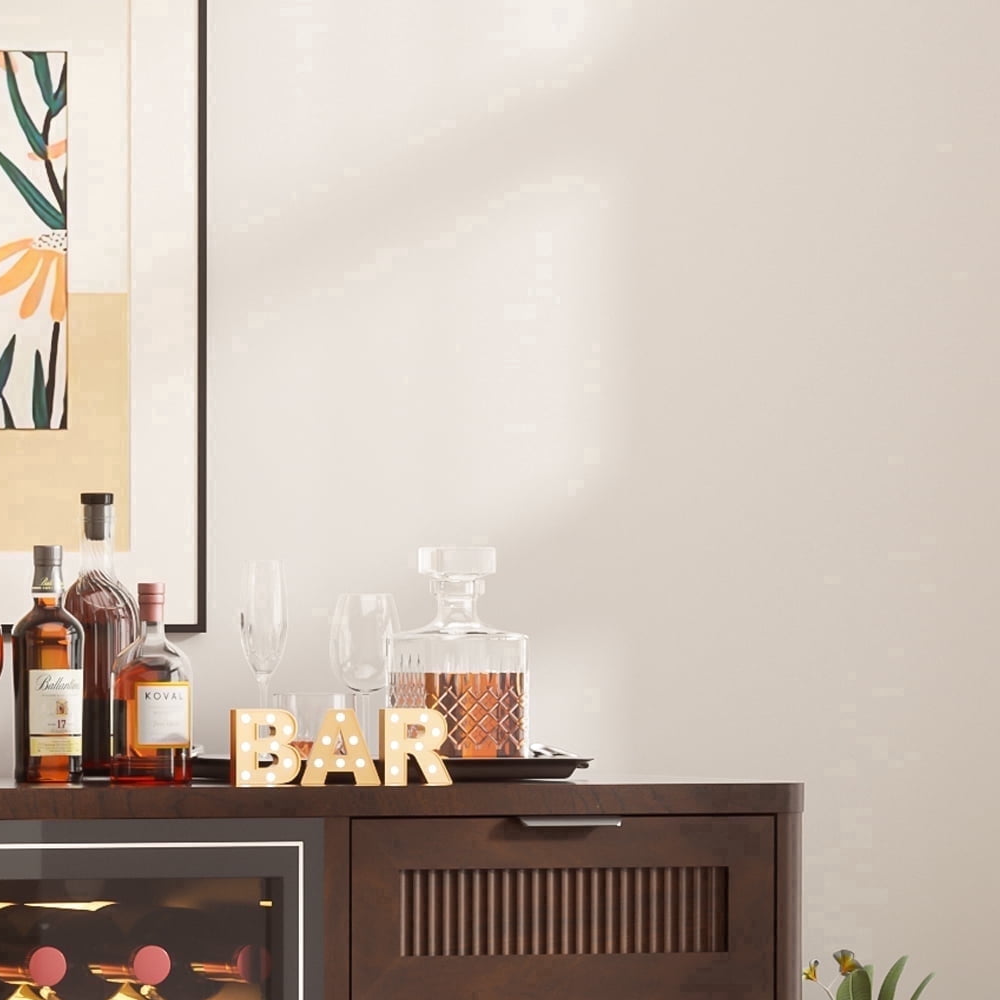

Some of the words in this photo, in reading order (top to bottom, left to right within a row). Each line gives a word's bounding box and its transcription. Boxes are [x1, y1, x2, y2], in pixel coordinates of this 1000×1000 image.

[144, 691, 184, 701] KOVAL
[57, 719, 67, 729] 17
[230, 708, 454, 788] BAR
